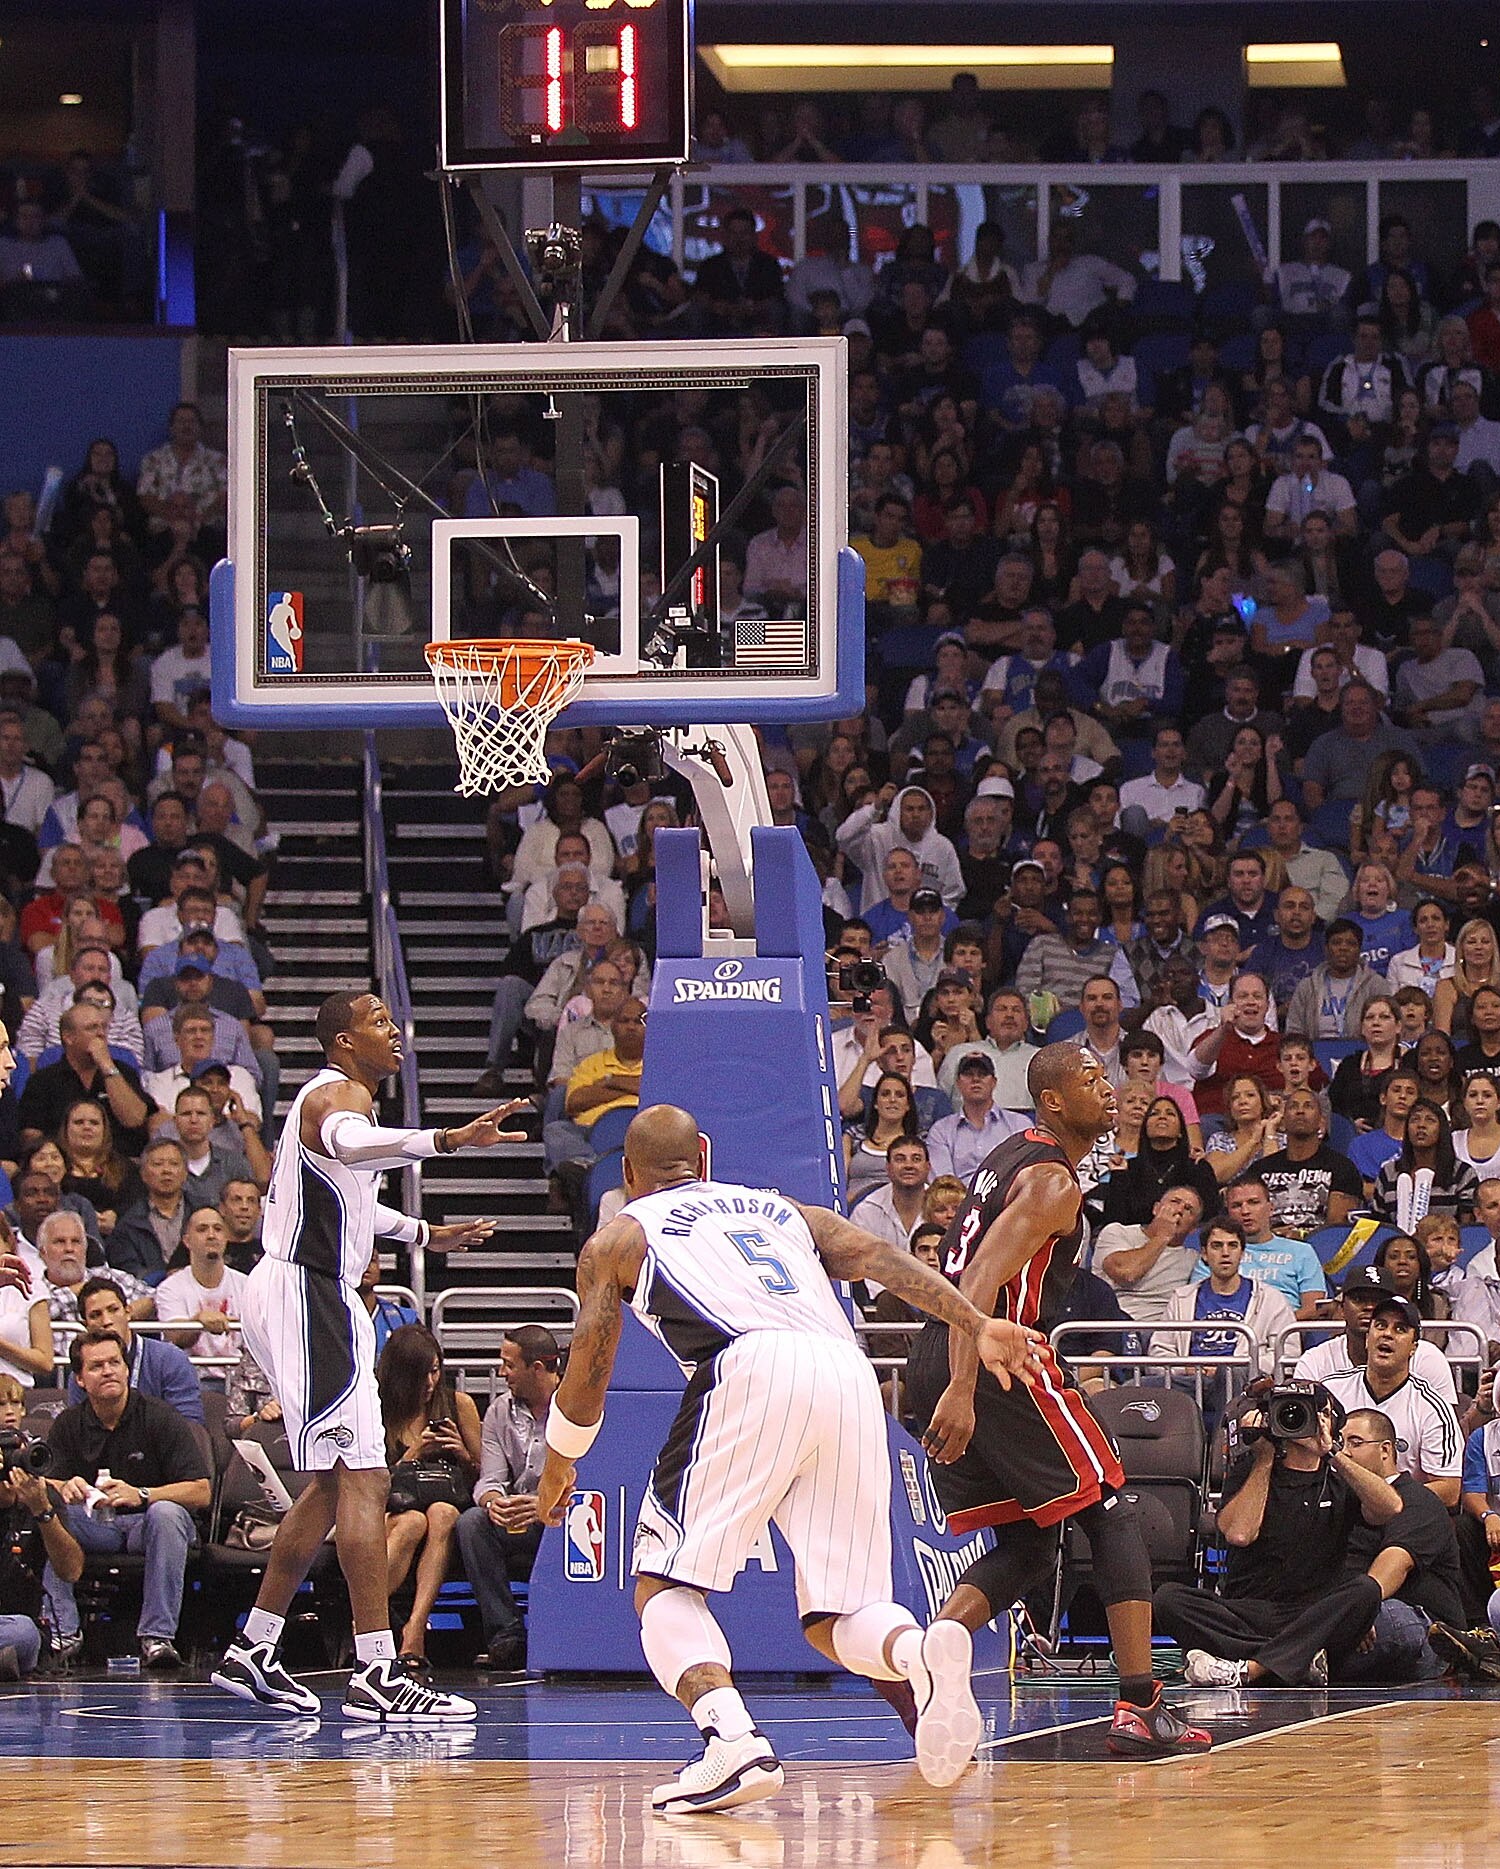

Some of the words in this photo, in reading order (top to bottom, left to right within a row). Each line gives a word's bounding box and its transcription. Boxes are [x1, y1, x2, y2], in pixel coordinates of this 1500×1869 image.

[545, 24, 641, 133] 11
[271, 656, 292, 669] NBA
[674, 977, 782, 1003] SPALDING
[661, 1198, 792, 1238] RICHARDSON
[724, 1229, 799, 1295] 5
[569, 1561, 592, 1575] NBA
